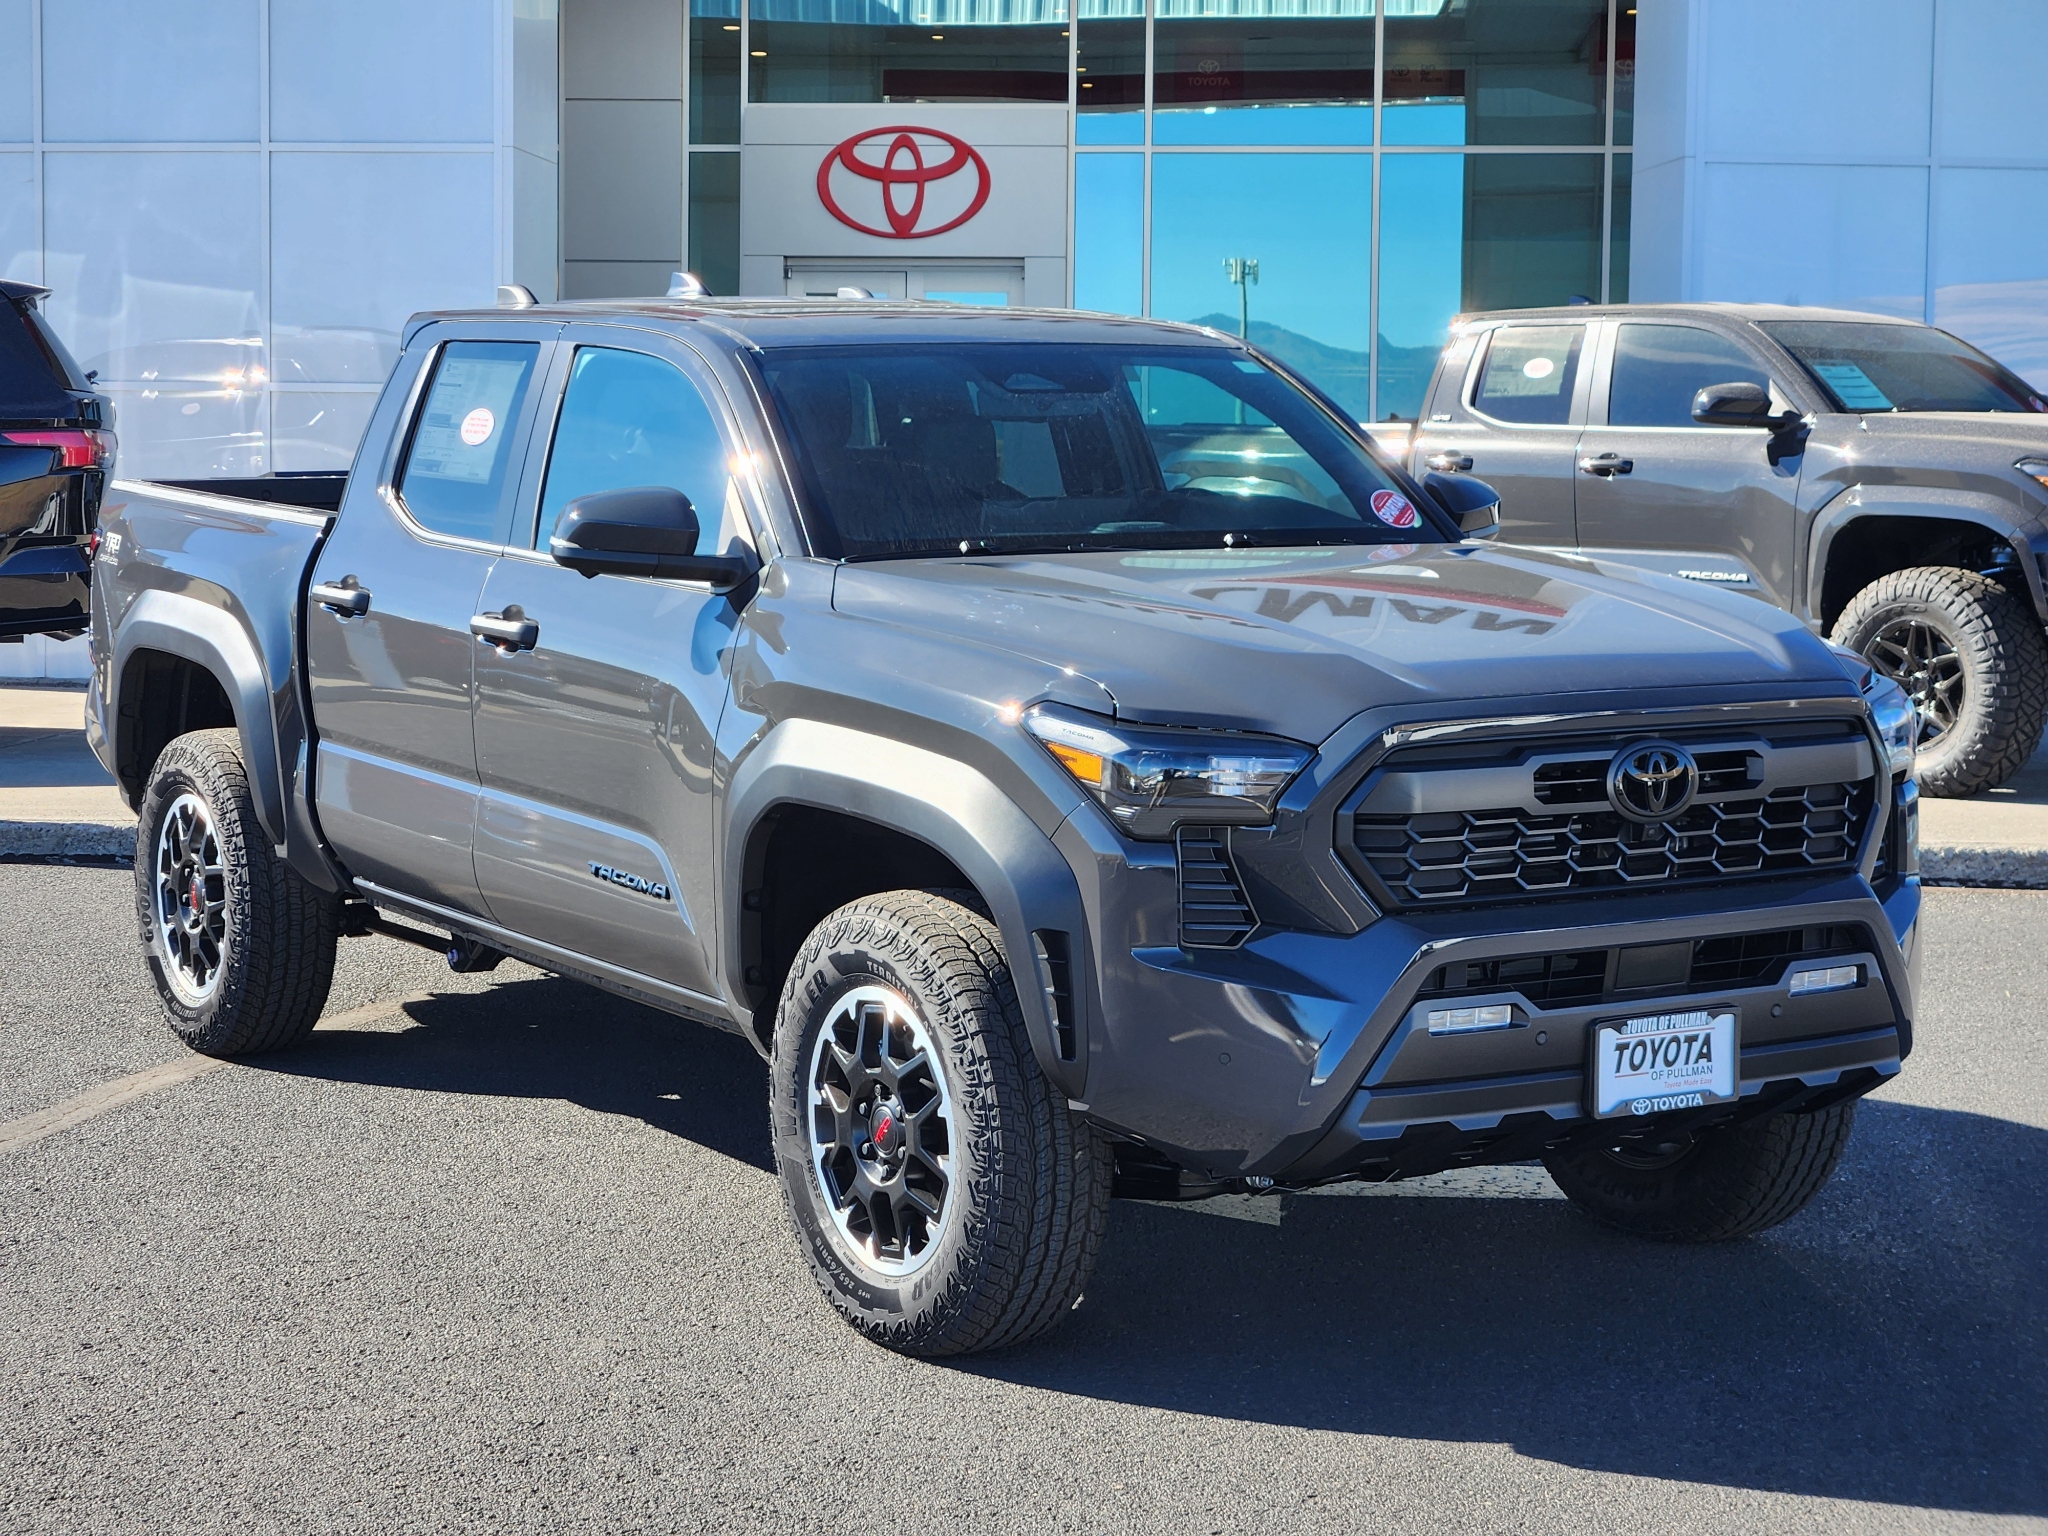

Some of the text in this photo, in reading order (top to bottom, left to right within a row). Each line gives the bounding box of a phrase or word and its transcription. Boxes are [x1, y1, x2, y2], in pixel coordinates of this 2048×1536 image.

[1187, 76, 1231, 87] TOYOTA
[1677, 570, 1749, 583] TACOMA
[1061, 727, 1095, 741] TACOMA
[587, 860, 671, 902] TACOMA
[866, 960, 919, 1011] TERRITORY
[1626, 1011, 1708, 1034] TOYOTA OF PULLMAN
[781, 968, 830, 1138] WRANGLER
[1614, 1032, 1713, 1074] TOYOTA
[1651, 1065, 1713, 1081] OF PULLMAN
[1664, 1077, 1713, 1089] Toyota Made Easy
[1650, 1093, 1704, 1112] TOYOTA
